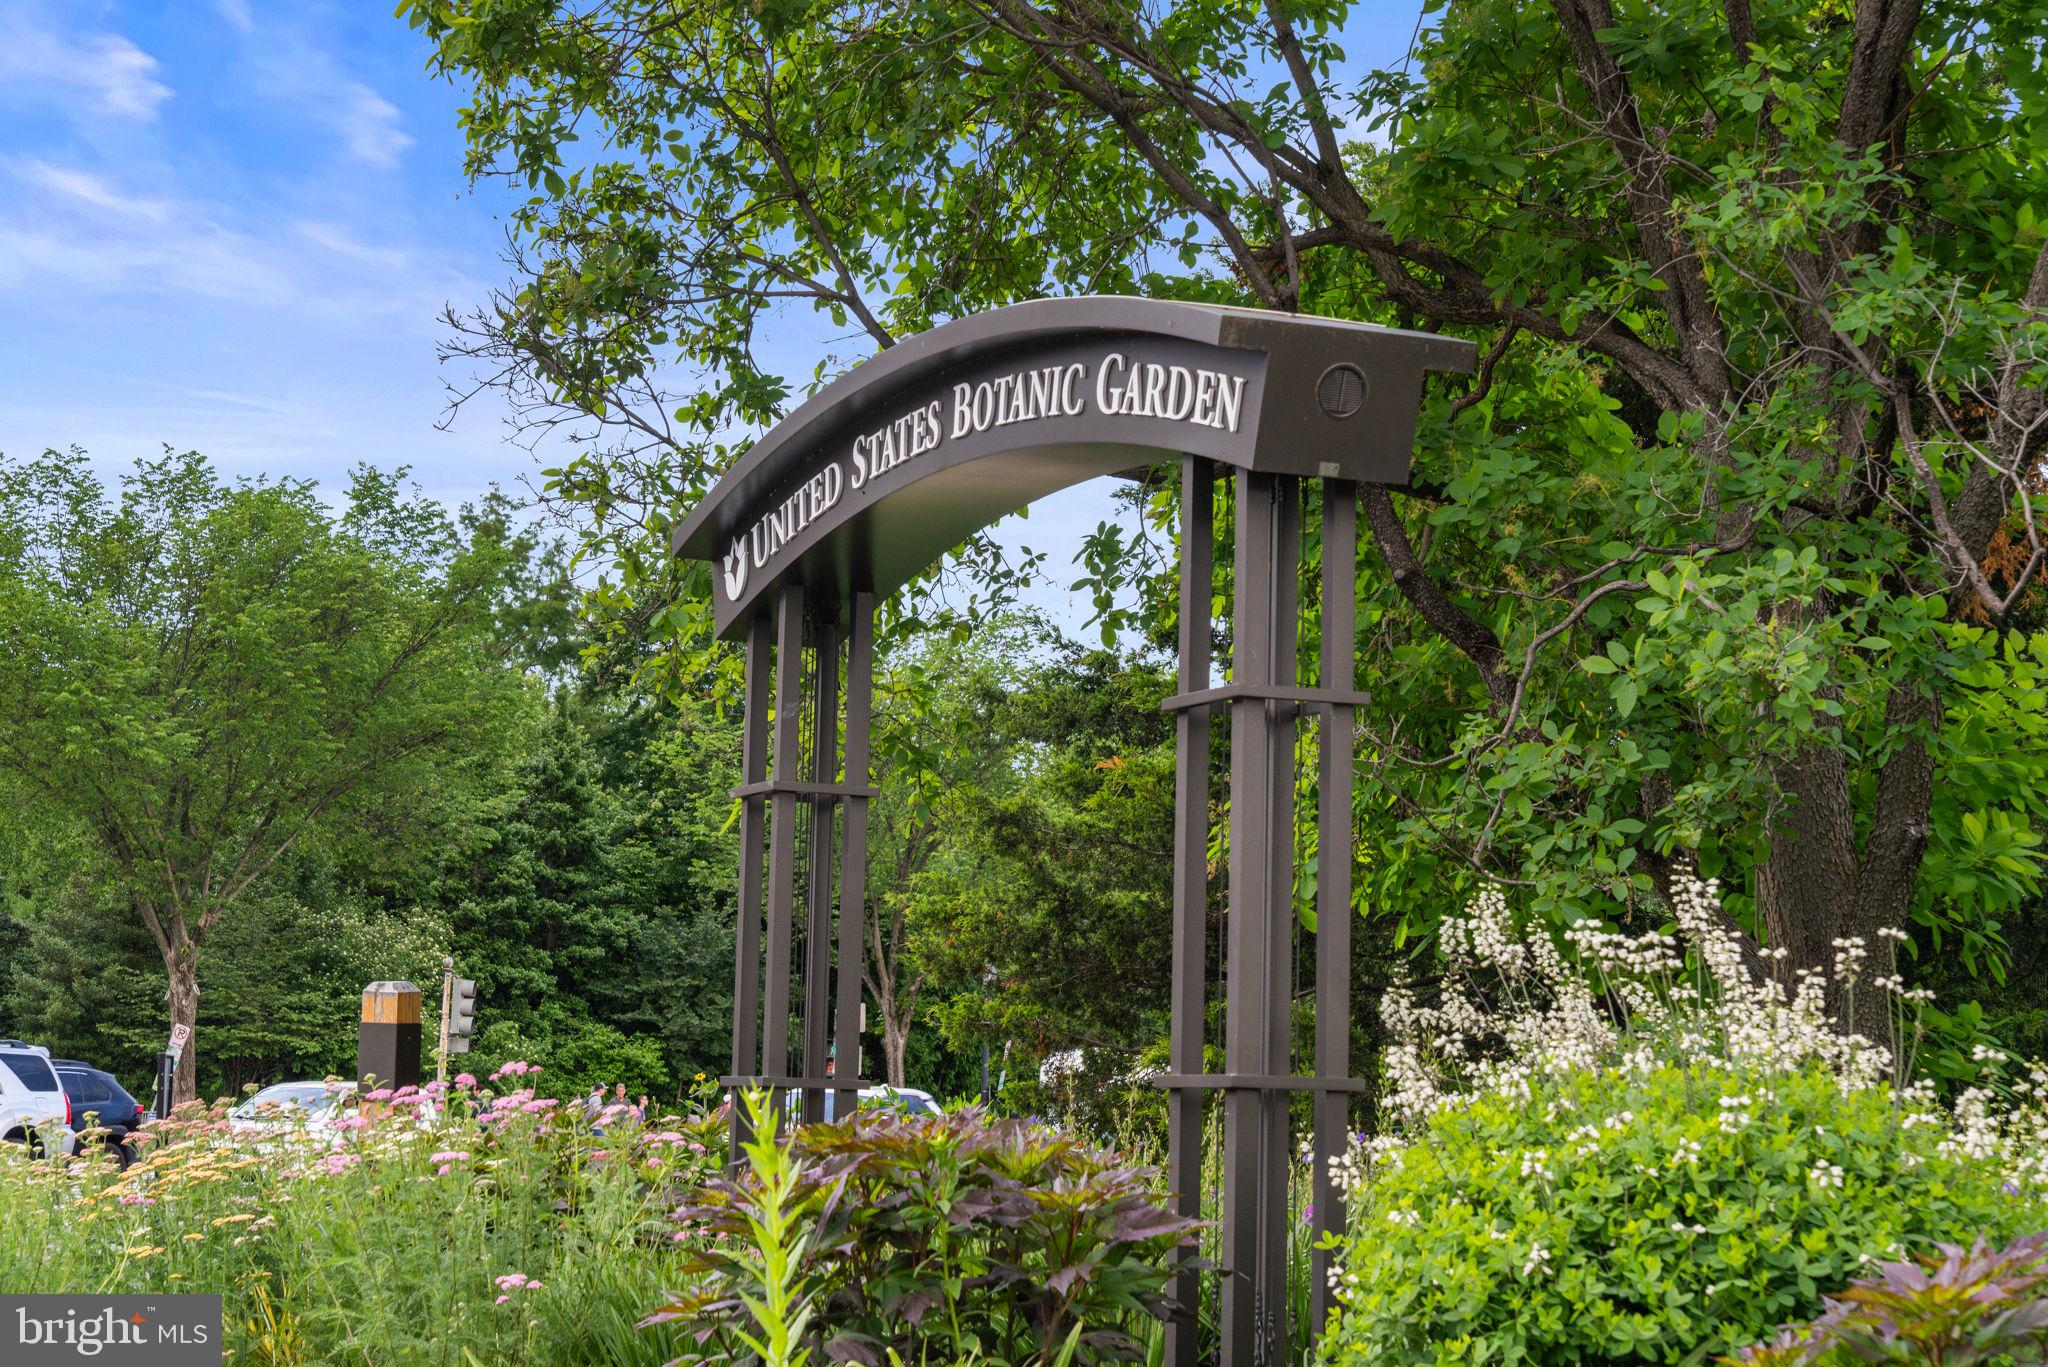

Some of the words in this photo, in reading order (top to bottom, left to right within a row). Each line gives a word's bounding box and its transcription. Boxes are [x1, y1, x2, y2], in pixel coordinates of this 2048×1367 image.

[750, 462, 844, 569] UNITED
[851, 400, 942, 490] STATES
[950, 362, 1086, 440] BOTANIC
[1095, 352, 1245, 433] GARDEN
